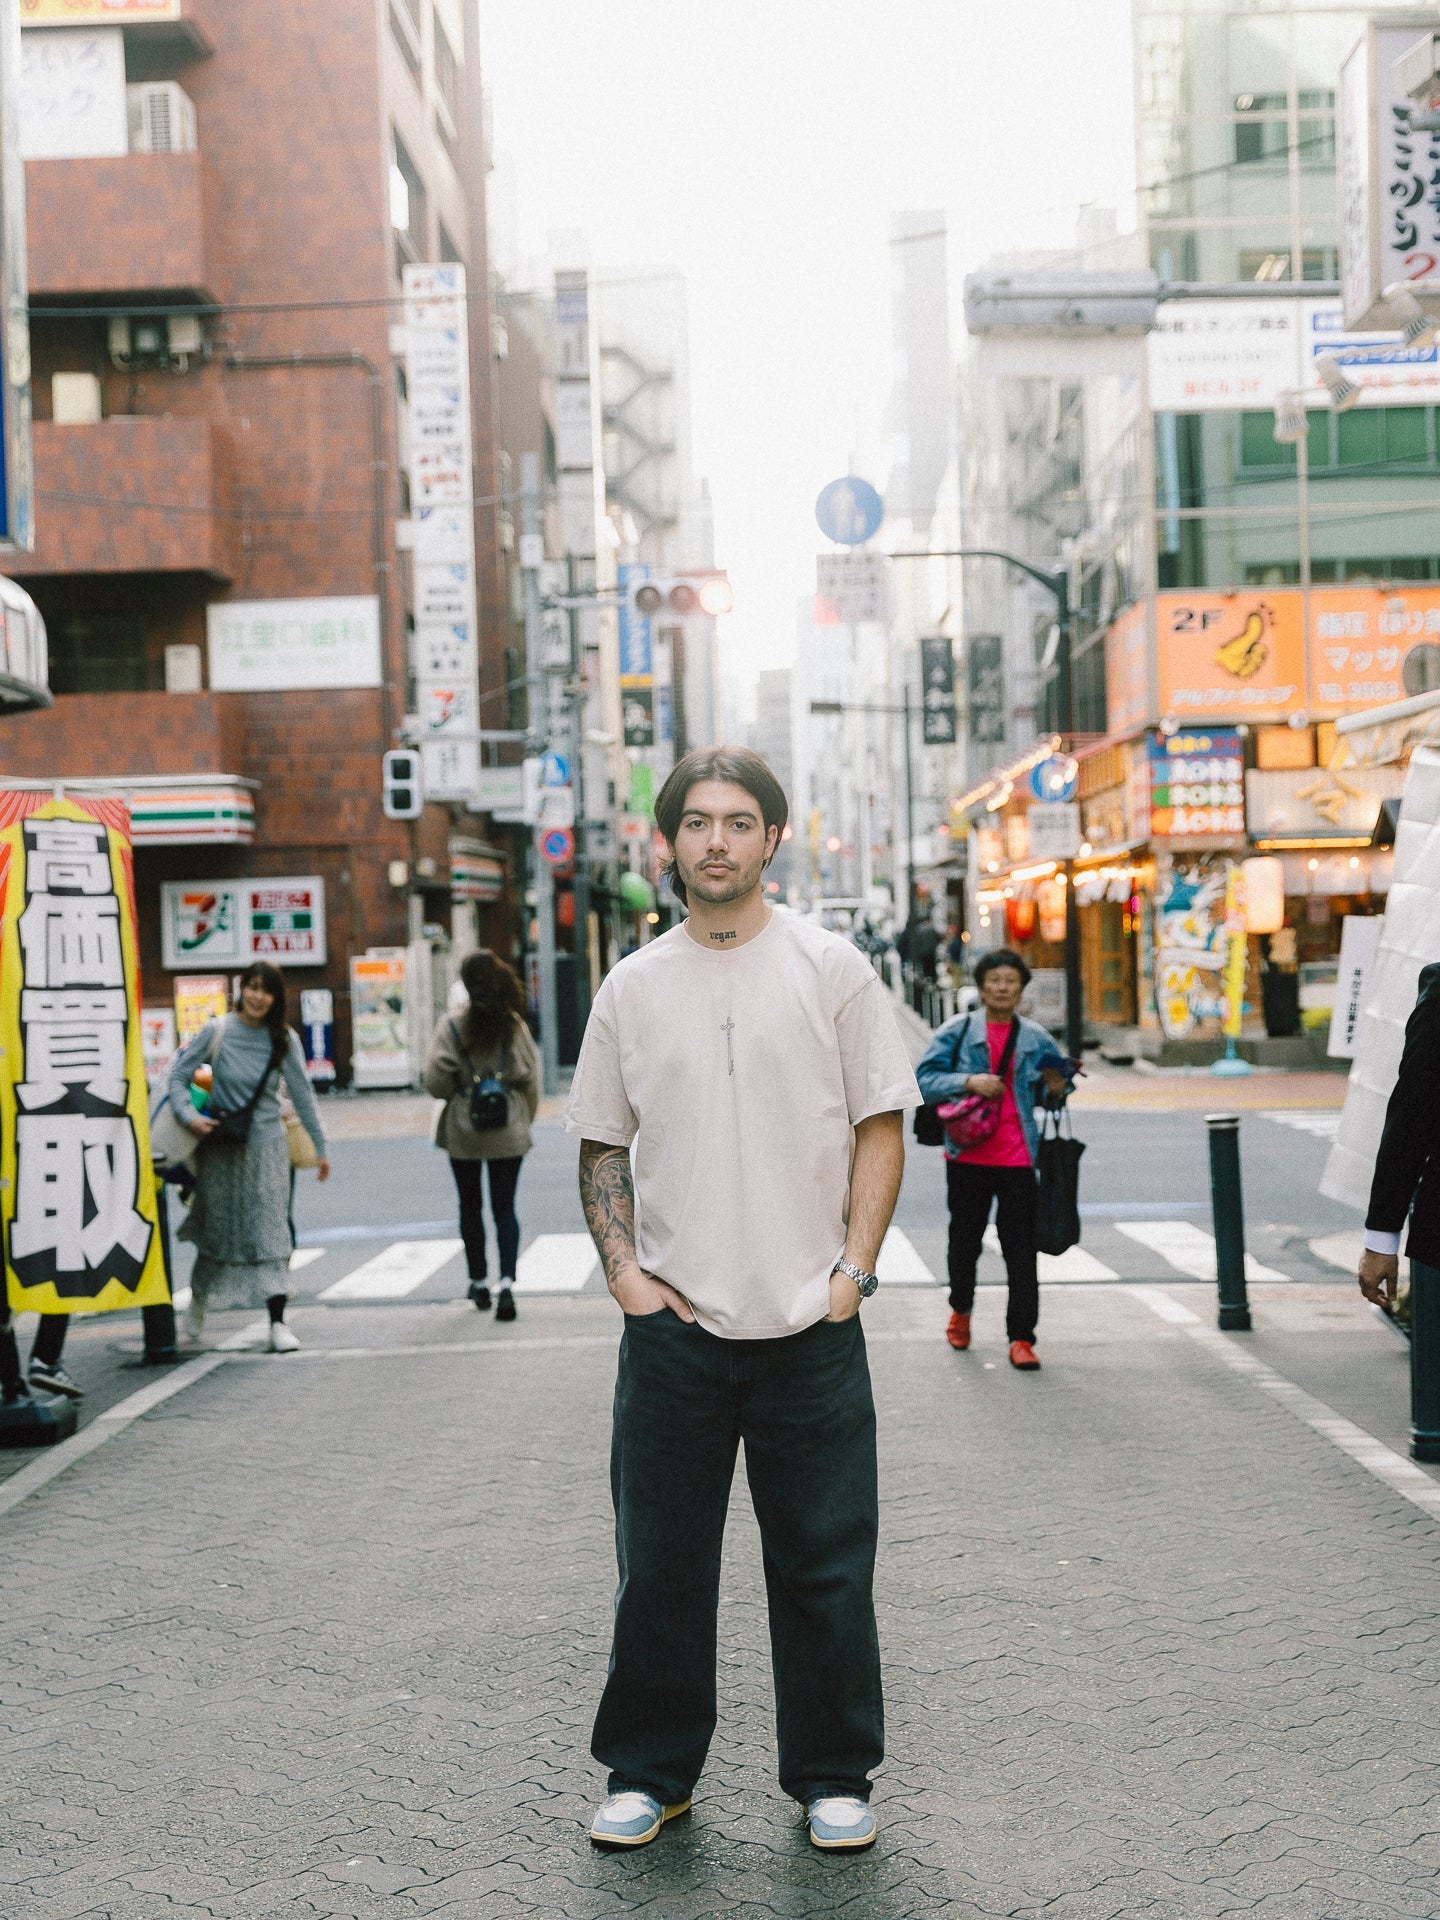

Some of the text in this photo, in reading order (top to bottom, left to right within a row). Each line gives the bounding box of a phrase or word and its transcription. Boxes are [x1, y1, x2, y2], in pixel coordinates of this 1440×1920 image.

[1172, 609, 1223, 632] 2F
[709, 929, 737, 943] vegan
[10, 819, 153, 1290] 高価買取
